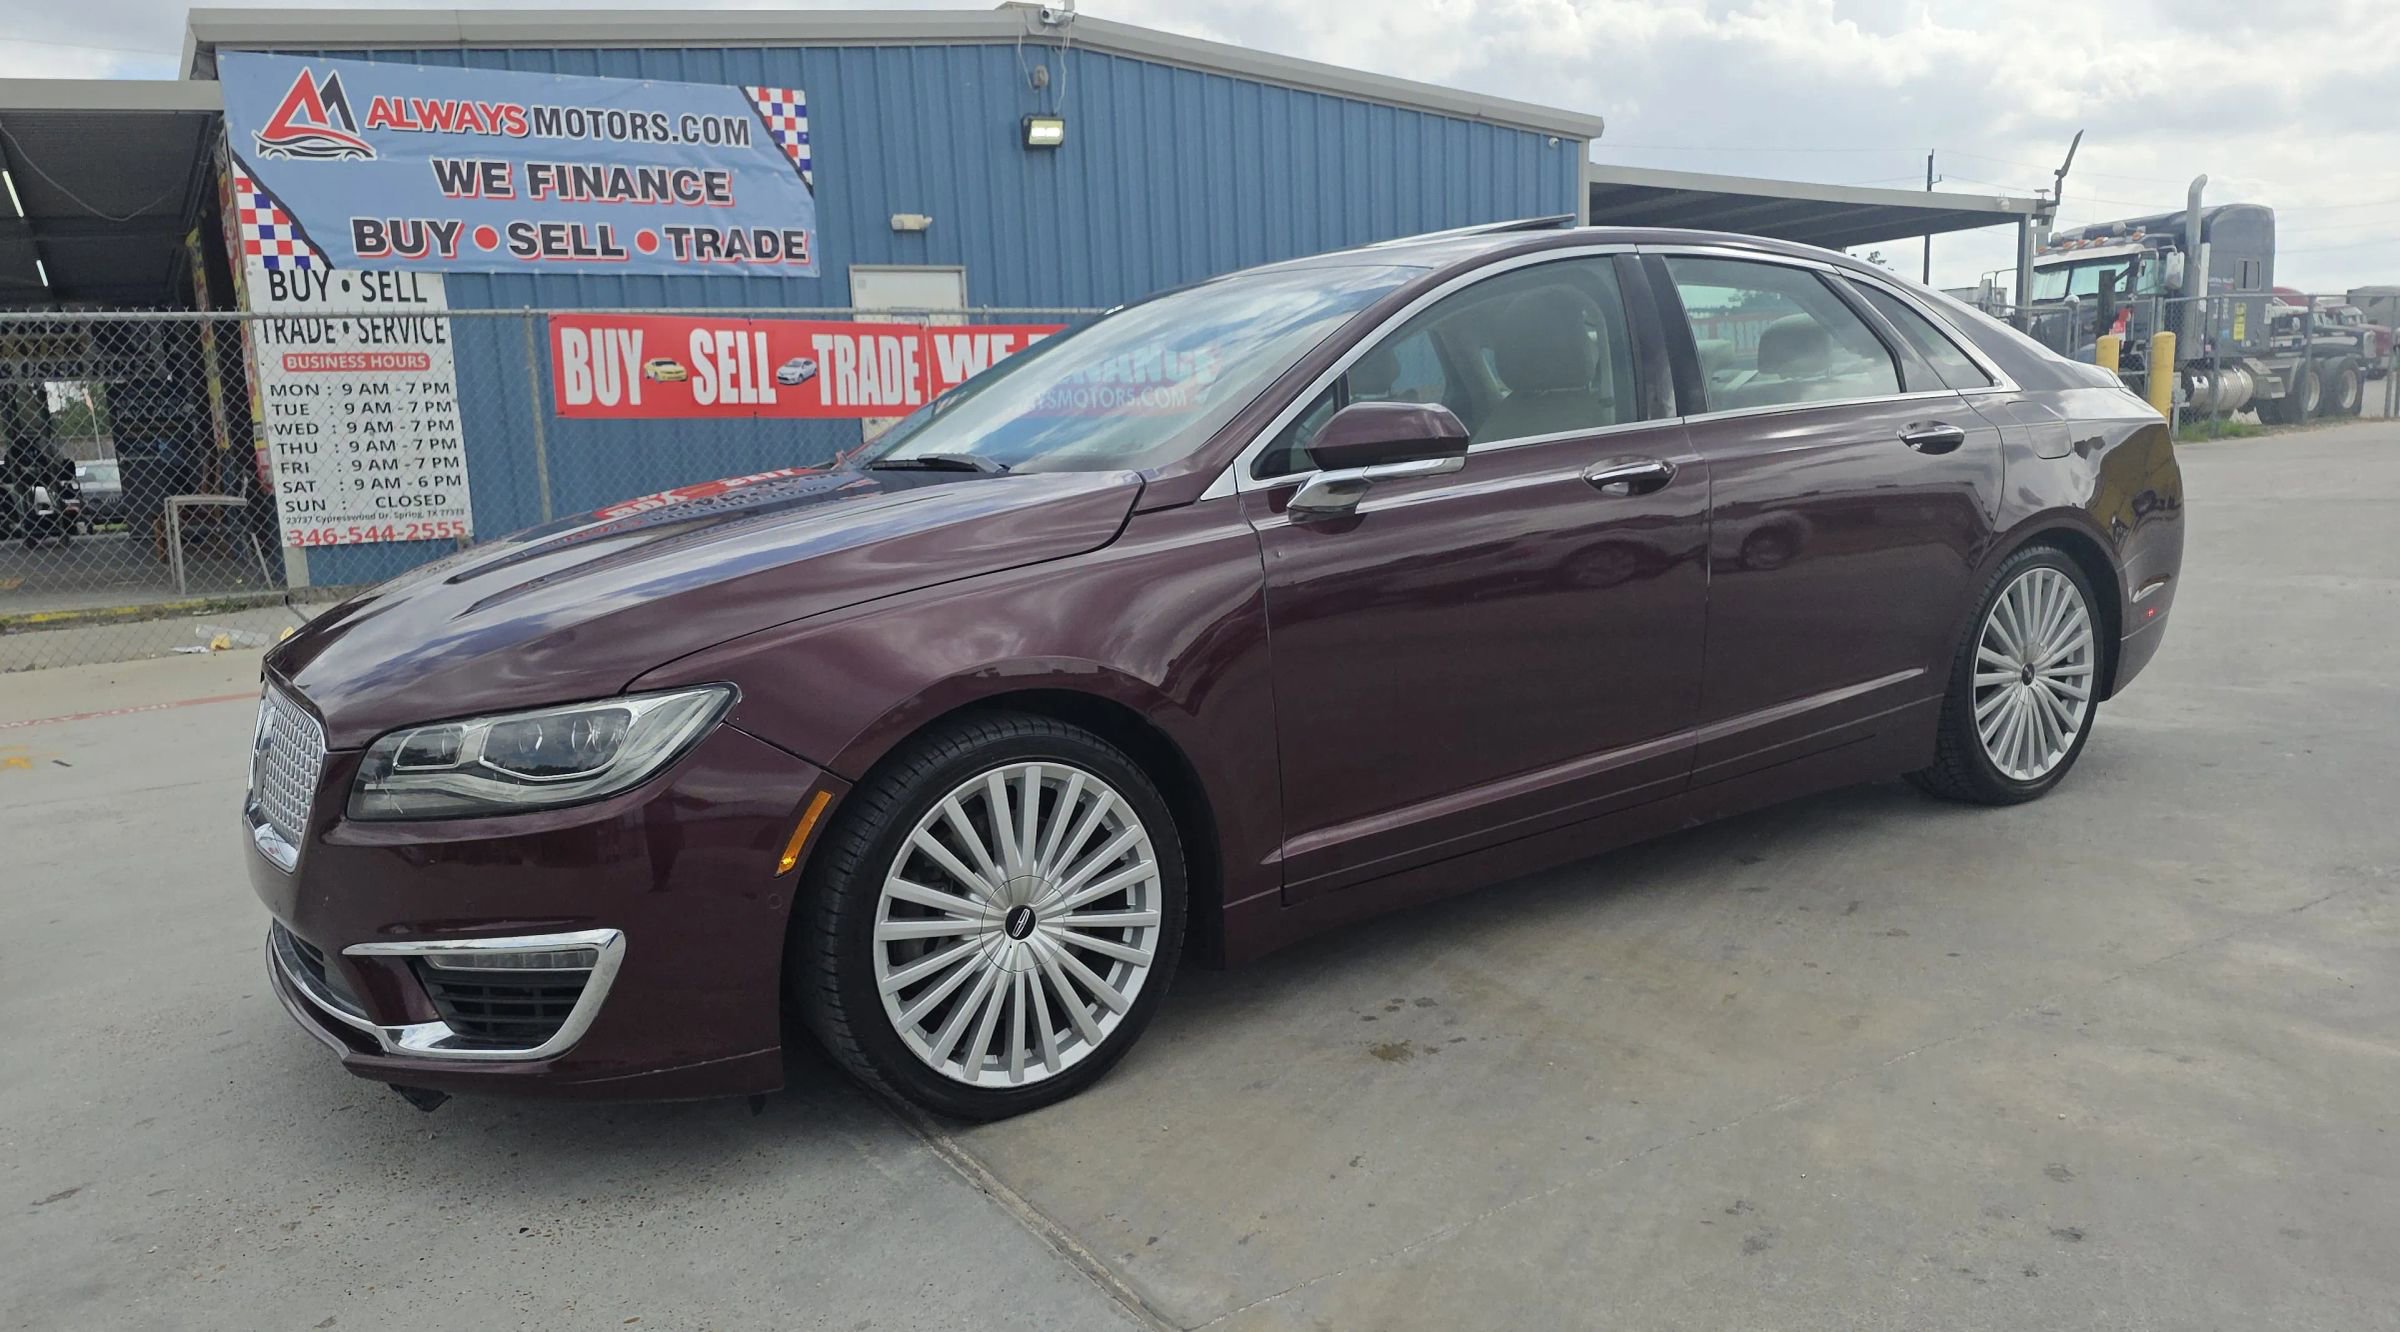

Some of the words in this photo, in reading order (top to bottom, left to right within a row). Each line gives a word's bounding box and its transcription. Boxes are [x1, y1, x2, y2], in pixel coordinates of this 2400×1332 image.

[366, 96, 752, 148] ALWAYSMOTORS.COM
[431, 158, 514, 200] WE
[527, 160, 734, 206] FINANCE
[351, 217, 464, 259] BUY
[506, 221, 629, 261] SELL
[664, 225, 811, 266] TRADE
[269, 269, 330, 302] BUY
[360, 271, 428, 303] SELL
[357, 317, 447, 345] SERVICE
[287, 355, 365, 370] BUSINESS
[371, 355, 427, 369] HOURS
[560, 327, 644, 406] BUY
[689, 329, 777, 406] SELL
[812, 331, 922, 406] TRADE
[270, 384, 320, 397] MON
[342, 383, 352, 396] 9
[359, 383, 389, 396] AM
[405, 382, 415, 395] 7
[423, 382, 449, 394] PM
[272, 403, 310, 416] TUE
[344, 402, 354, 415] 9
[362, 402, 391, 414] AM
[408, 401, 418, 413] 7
[425, 401, 452, 413] PM
[275, 423, 319, 436] WED
[347, 422, 357, 434] 9
[363, 421, 394, 433] AM
[410, 420, 420, 432] 7
[427, 420, 454, 432] PM
[277, 442, 318, 455] THU
[349, 441, 360, 453] 9
[365, 440, 396, 452] AM
[413, 439, 423, 450] 7
[430, 438, 457, 450] PM
[281, 462, 310, 474] FRI
[351, 459, 362, 471] 9
[368, 459, 398, 471] AM
[415, 457, 425, 469] 7
[432, 457, 459, 469] PM
[283, 481, 317, 493] SAT
[354, 478, 364, 490] 9
[371, 477, 401, 490] AM
[418, 475, 428, 488] 6
[435, 475, 461, 487] PM
[285, 499, 326, 513] SUN
[375, 494, 447, 509] CLOSED
[288, 520, 466, 547] 346-544-2555
